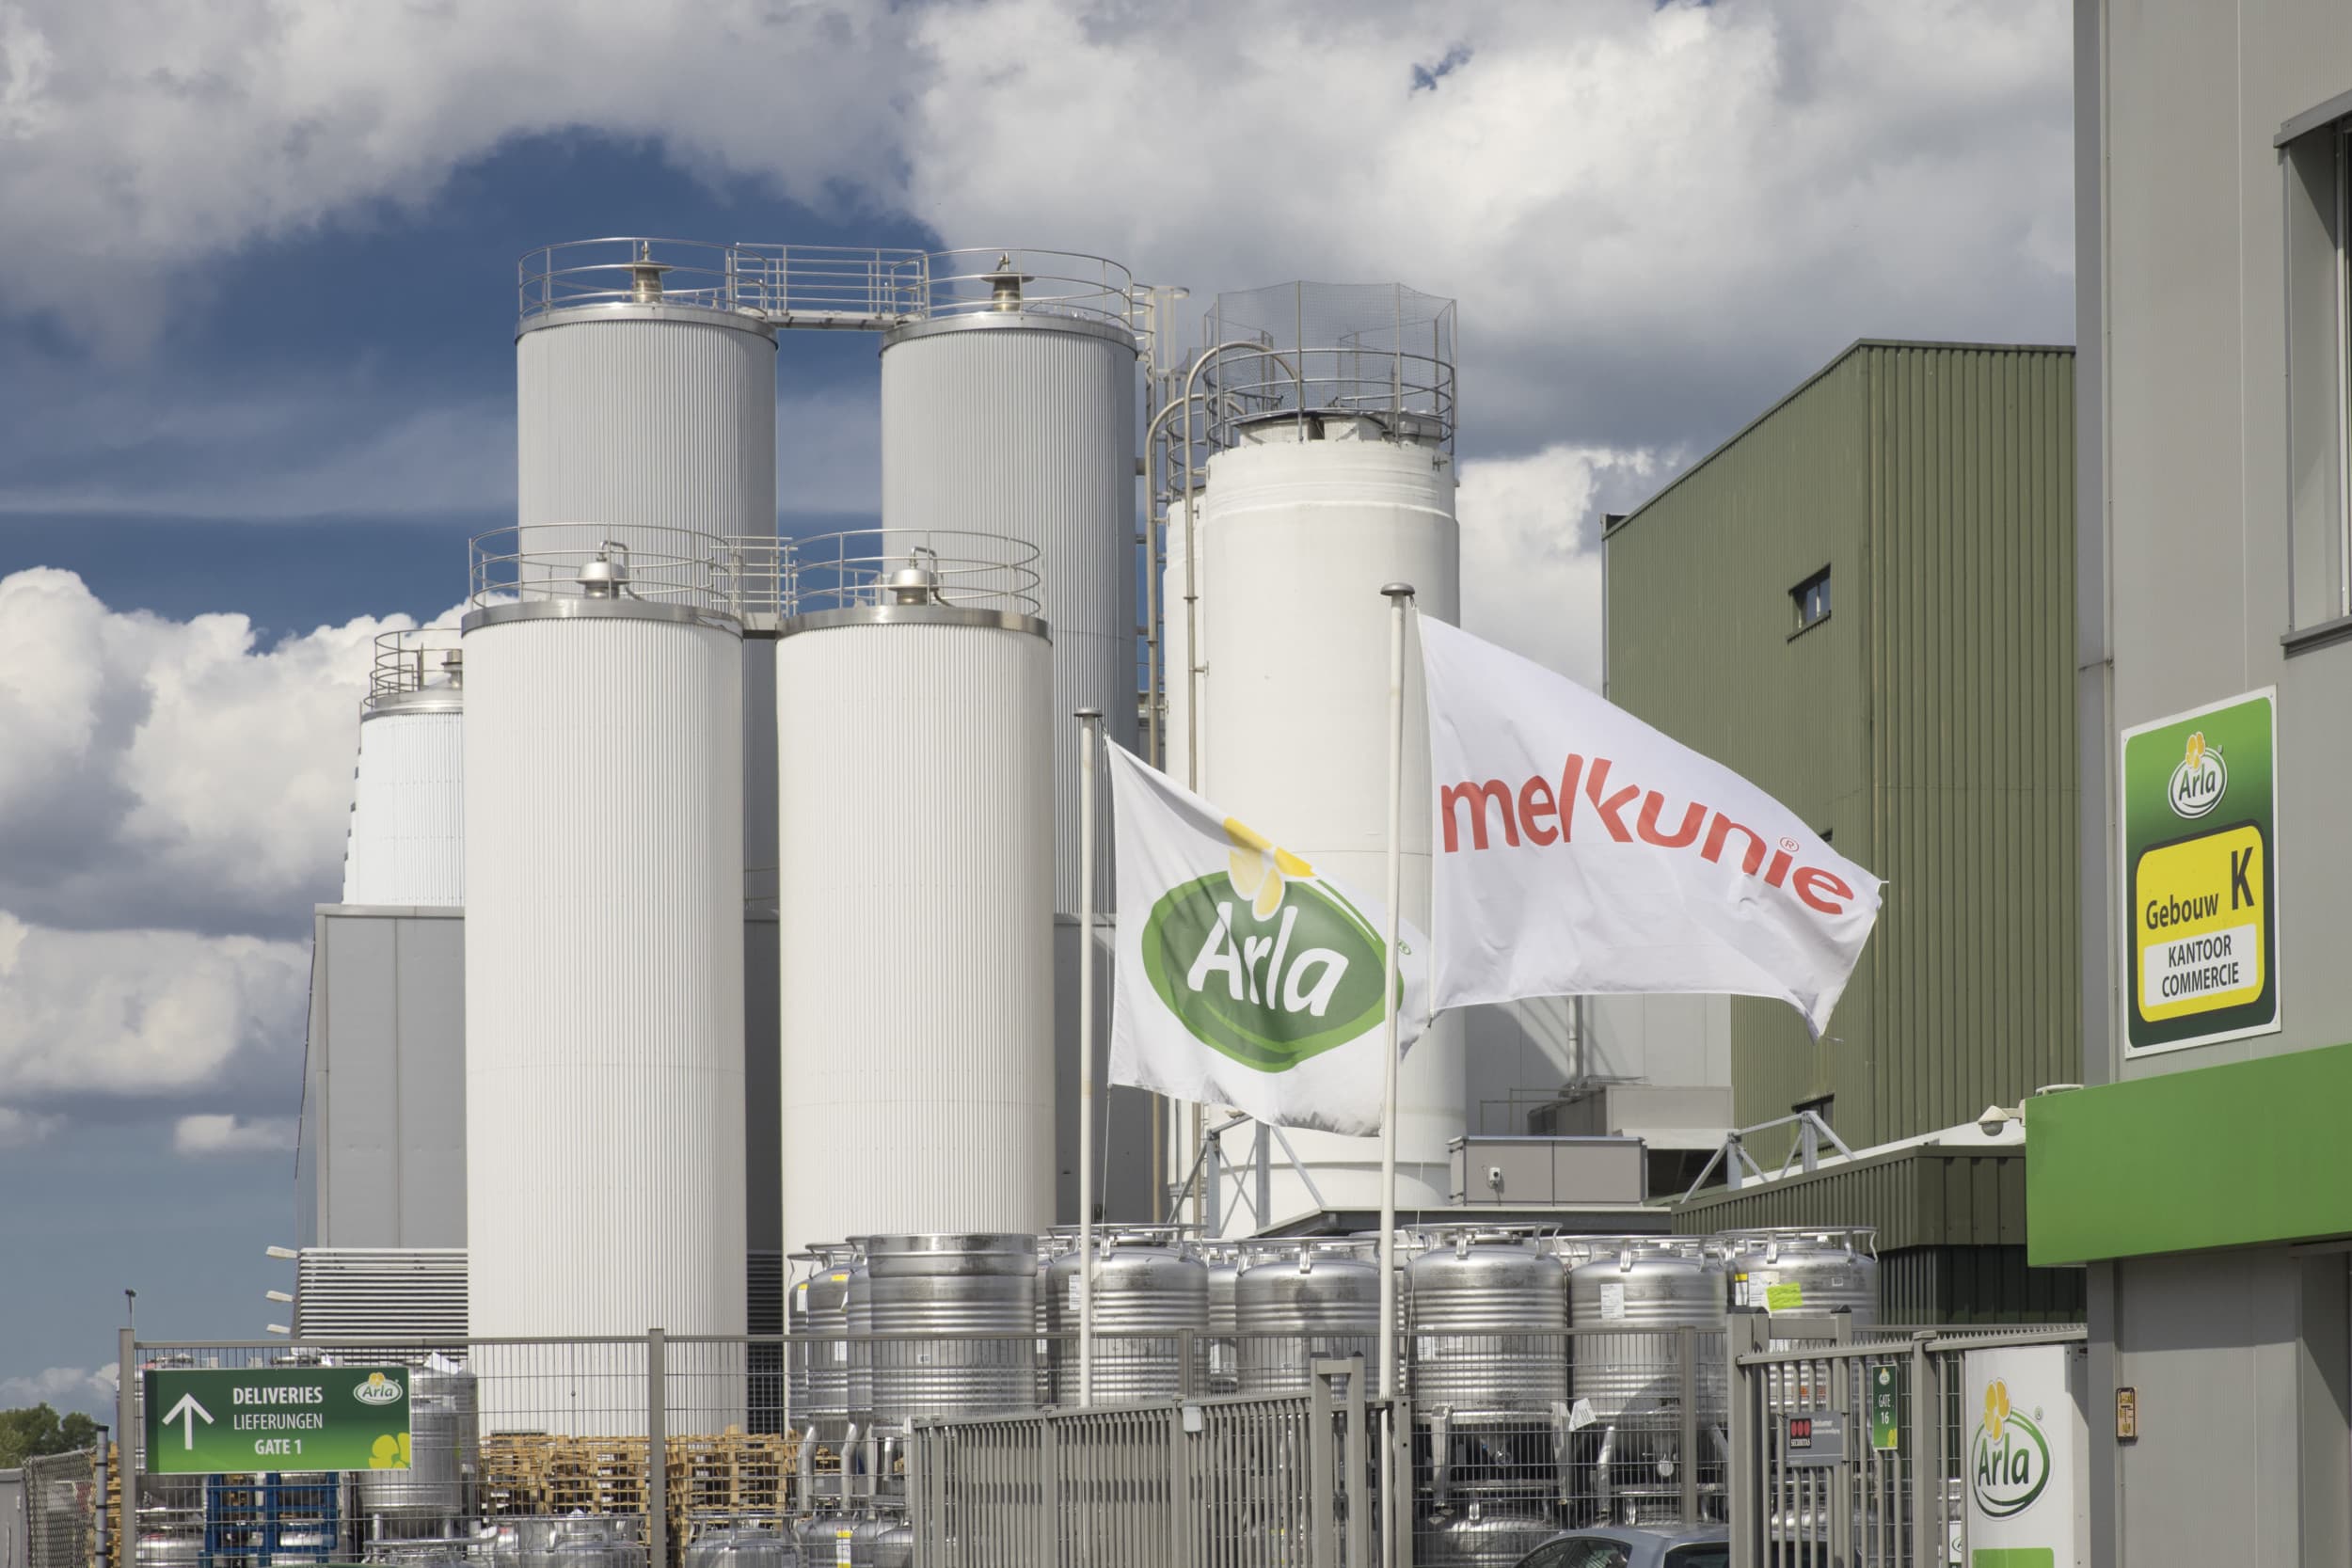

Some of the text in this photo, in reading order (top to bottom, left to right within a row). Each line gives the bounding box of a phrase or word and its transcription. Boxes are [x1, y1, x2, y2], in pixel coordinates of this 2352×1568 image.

[2179, 765, 2216, 800] Arla
[1440, 753, 1854, 915] melkunie
[2145, 847, 2255, 930] Gebouw K
[1186, 901, 1349, 1017] Arla
[2168, 934, 2233, 969] KANTOOR
[2162, 961, 2239, 998] COMMERCIE
[232, 1386, 324, 1405] DELIVERIES
[361, 1385, 394, 1400] Arla
[1878, 1394, 1891, 1408] GATE
[233, 1413, 324, 1431] LIEFERUNGEN
[1881, 1411, 1890, 1425] 16
[254, 1439, 302, 1455] GATE 1
[1978, 1433, 2030, 1487] Arla
